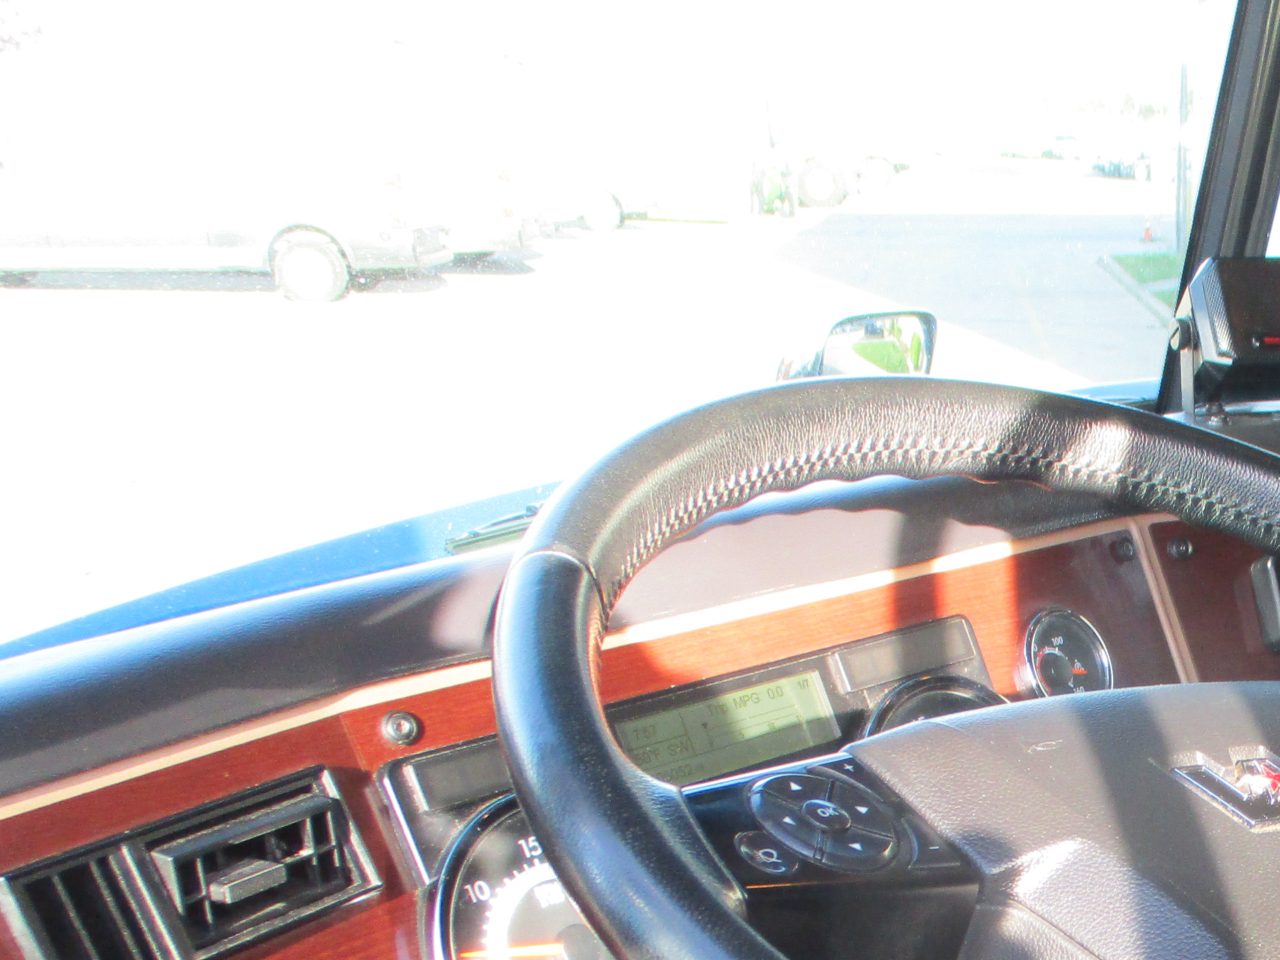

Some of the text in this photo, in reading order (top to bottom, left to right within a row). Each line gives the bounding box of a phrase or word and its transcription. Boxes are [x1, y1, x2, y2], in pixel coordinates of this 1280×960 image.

[1051, 635, 1064, 647] 100
[733, 692, 761, 710] MPG
[815, 806, 840, 818] OK
[518, 837, 543, 860] 15
[463, 880, 491, 904] 10
